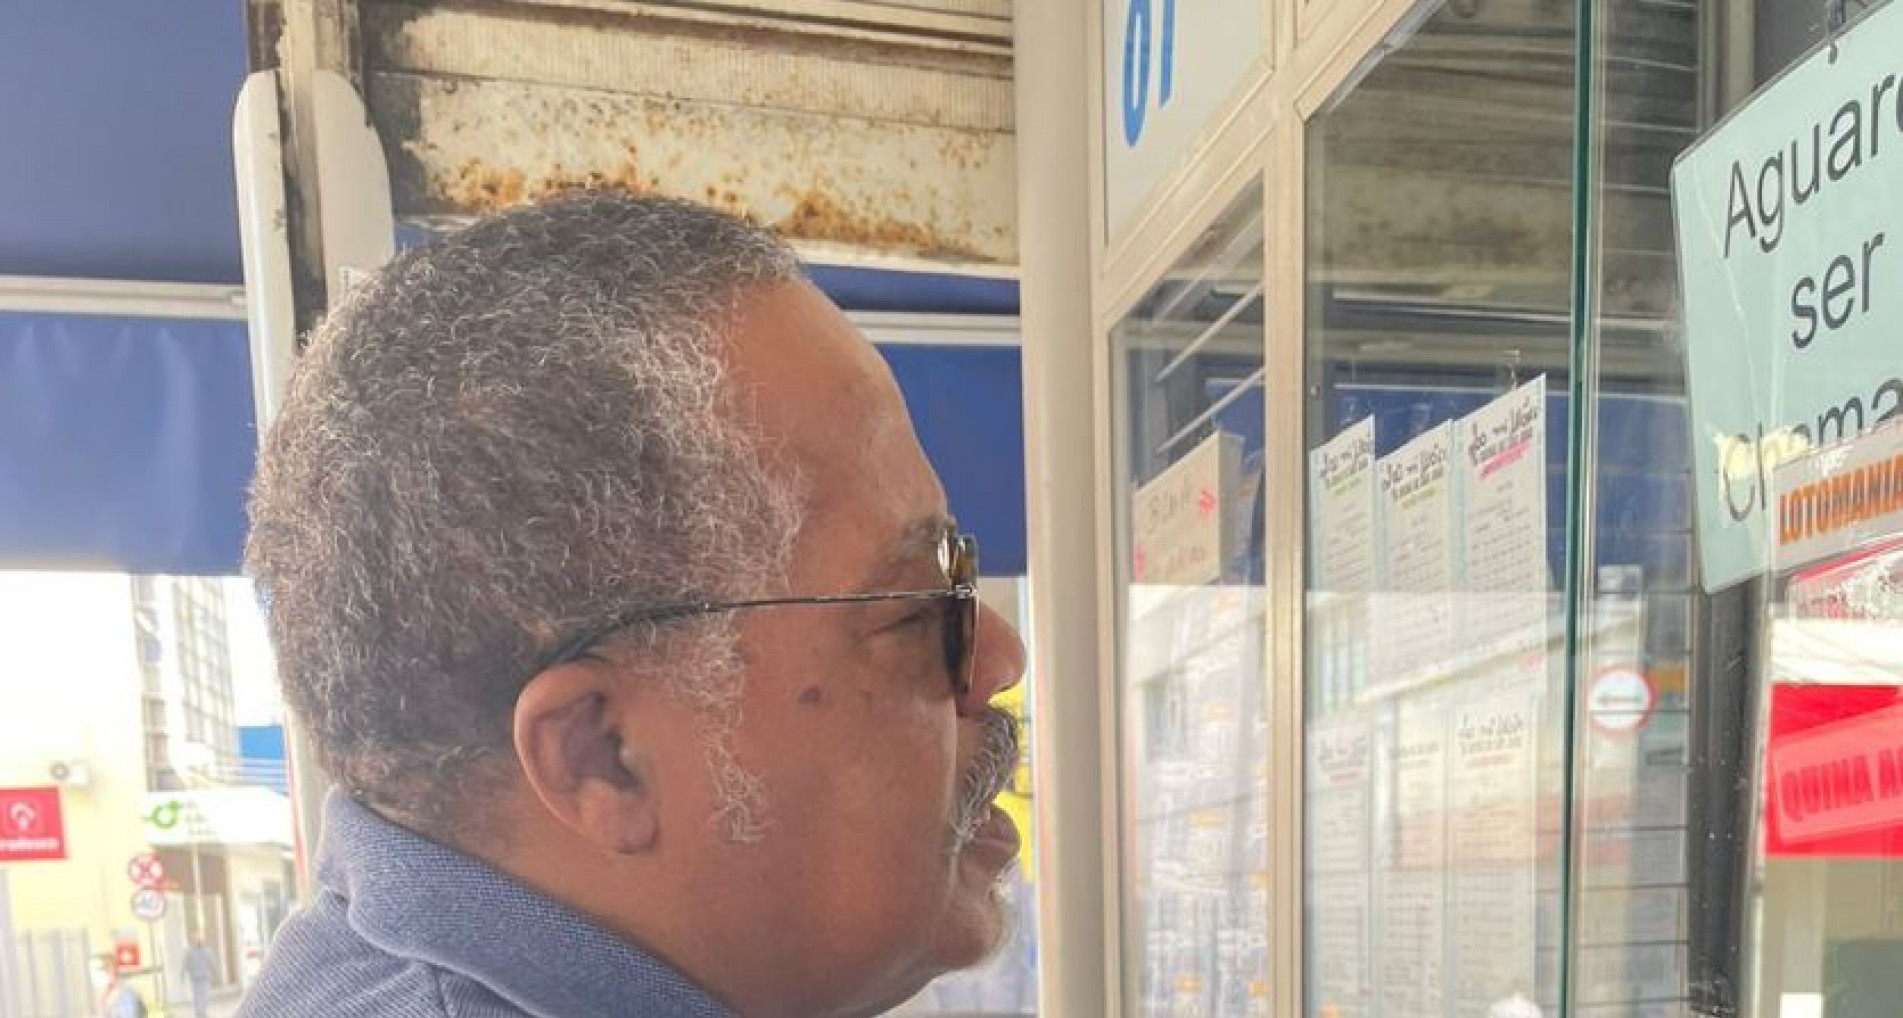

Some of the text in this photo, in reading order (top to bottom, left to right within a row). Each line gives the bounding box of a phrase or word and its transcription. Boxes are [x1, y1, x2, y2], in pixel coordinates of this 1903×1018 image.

[1723, 73, 1903, 260] Aguar
[1791, 231, 1885, 350] ser
[1780, 754, 1875, 823] QUINA
